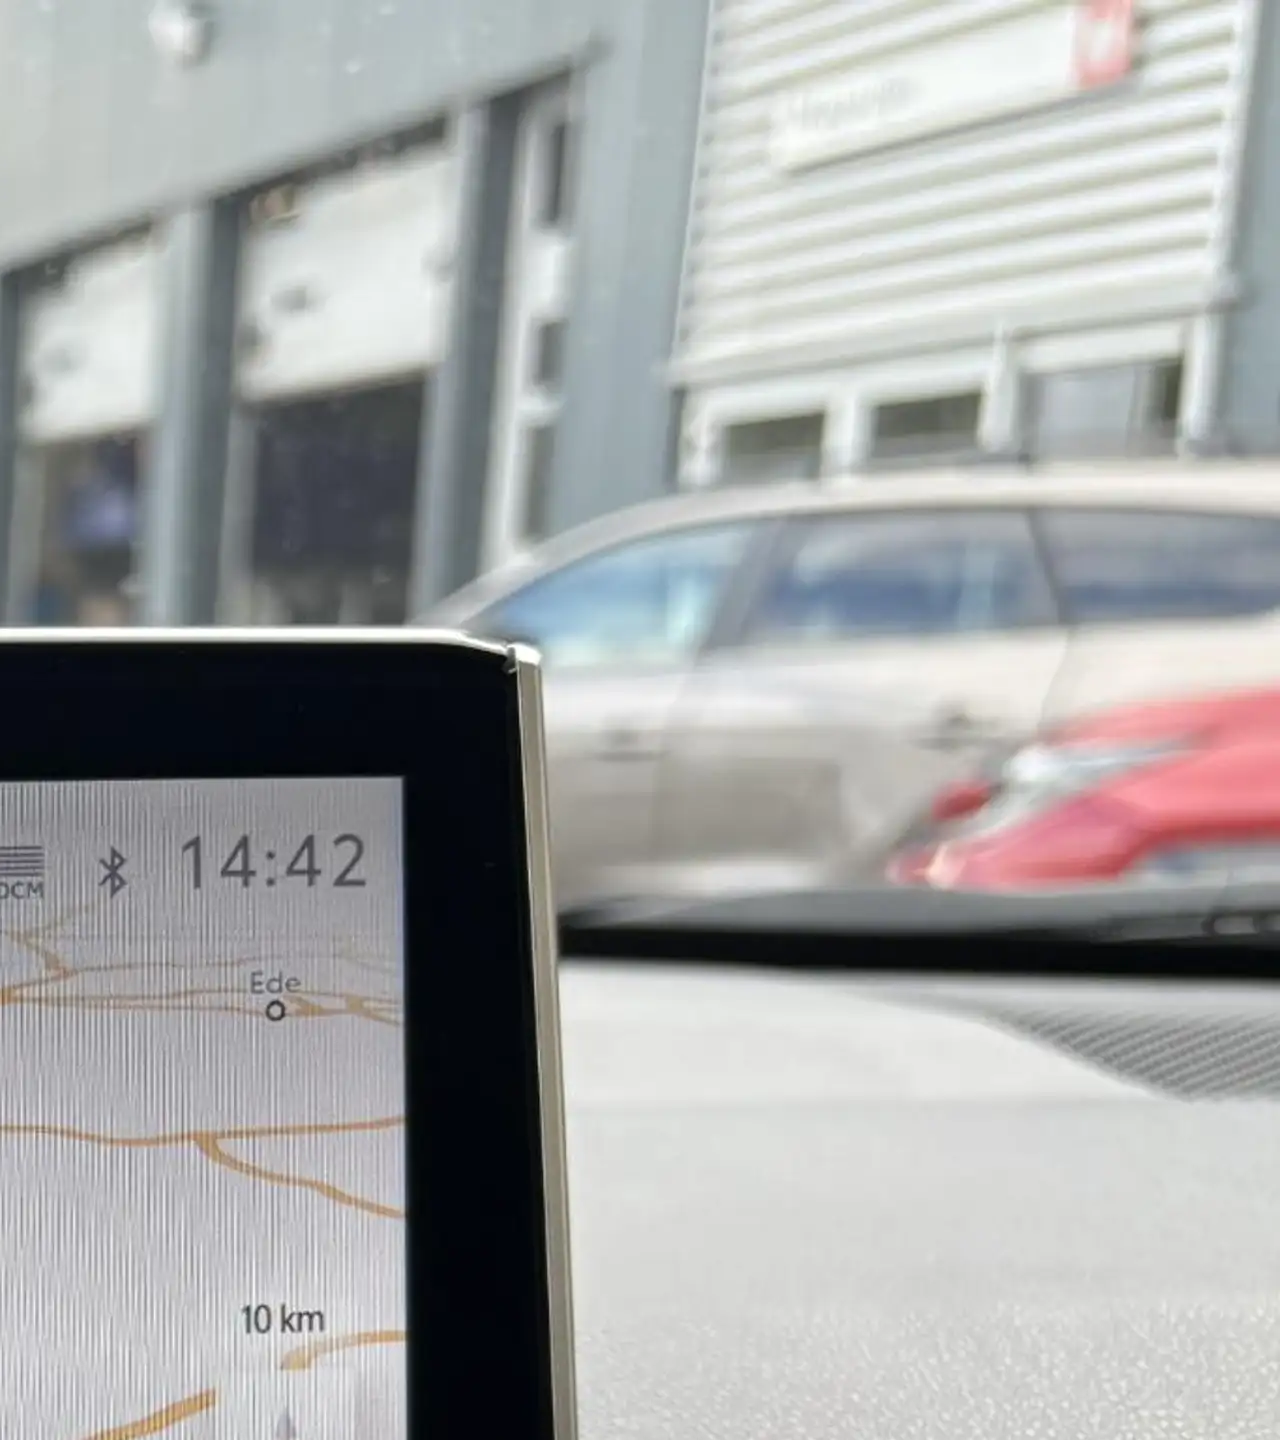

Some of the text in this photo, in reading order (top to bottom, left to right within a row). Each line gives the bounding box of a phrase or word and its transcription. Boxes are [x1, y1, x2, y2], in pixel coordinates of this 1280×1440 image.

[182, 832, 368, 890] 14:42
[250, 971, 302, 996] Ede
[241, 1302, 326, 1334] 10 km
